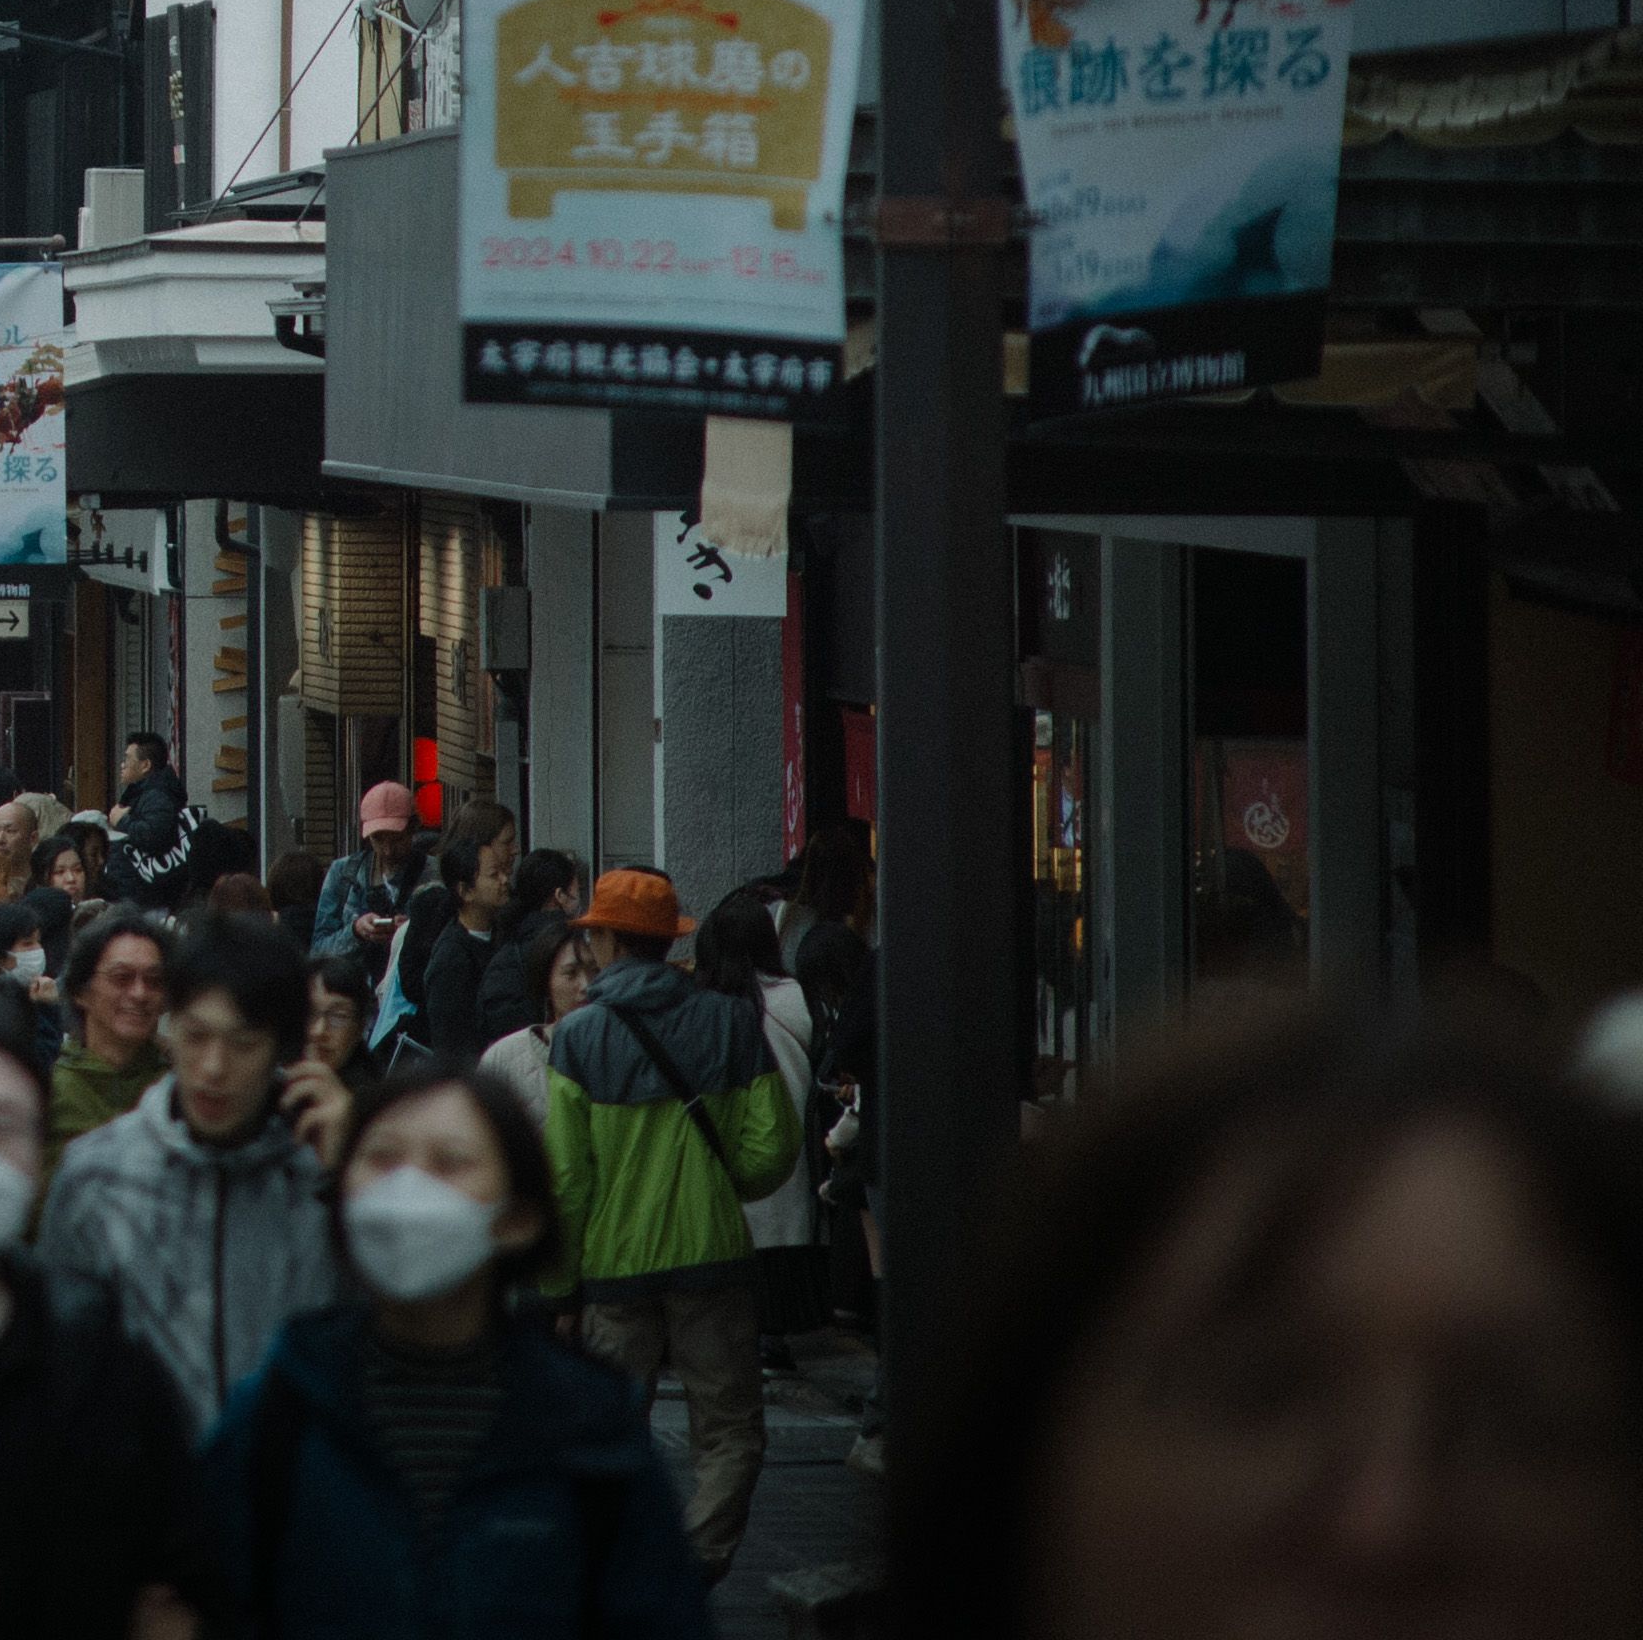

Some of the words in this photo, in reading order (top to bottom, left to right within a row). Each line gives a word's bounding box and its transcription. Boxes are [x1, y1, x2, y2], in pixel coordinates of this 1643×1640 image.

[514, 34, 812, 97] 人吉球磨の
[1020, 27, 1331, 117] 痕跡を探る
[569, 108, 763, 169] 玉手箱
